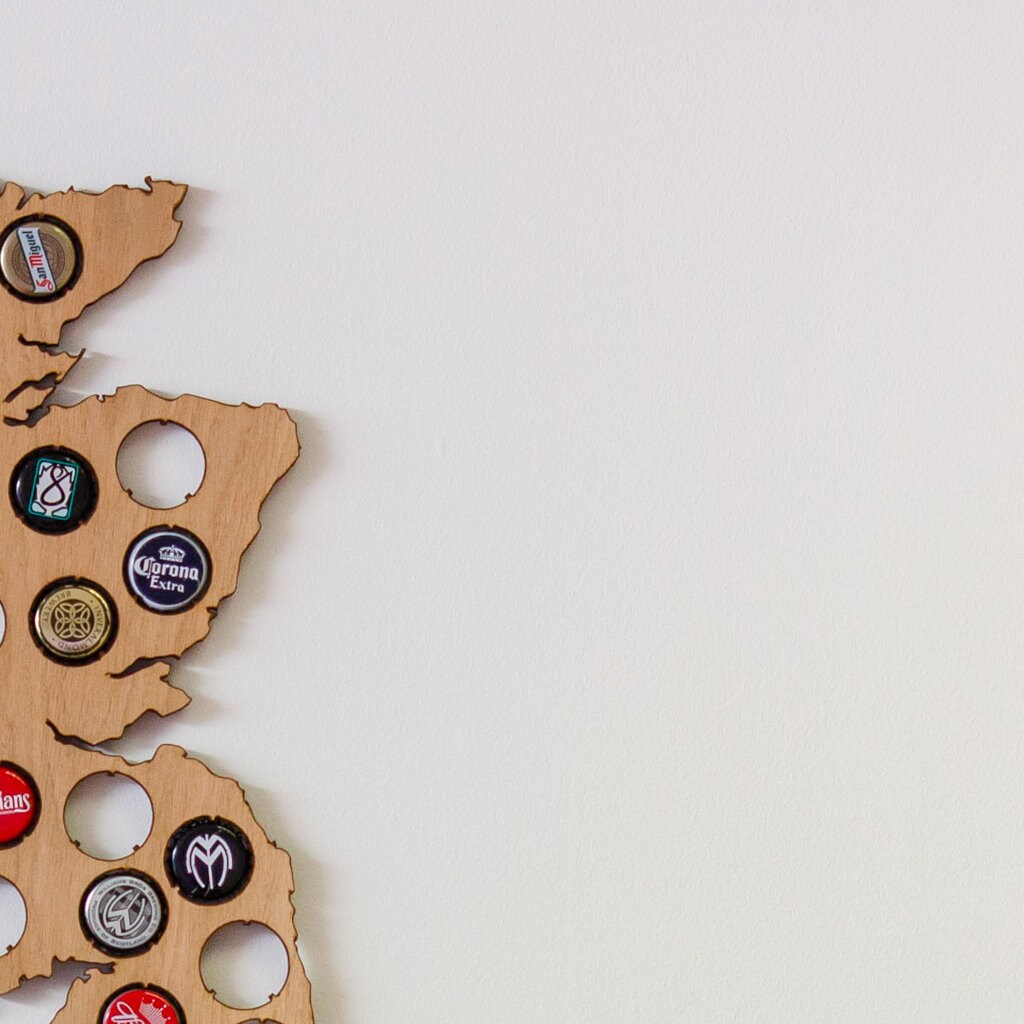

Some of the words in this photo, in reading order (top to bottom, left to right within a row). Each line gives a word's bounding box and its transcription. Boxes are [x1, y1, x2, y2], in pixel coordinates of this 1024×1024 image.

[22, 231, 45, 267] Miguel
[35, 266, 55, 291] San
[133, 556, 199, 580] Corona
[150, 576, 185, 593] Extra
